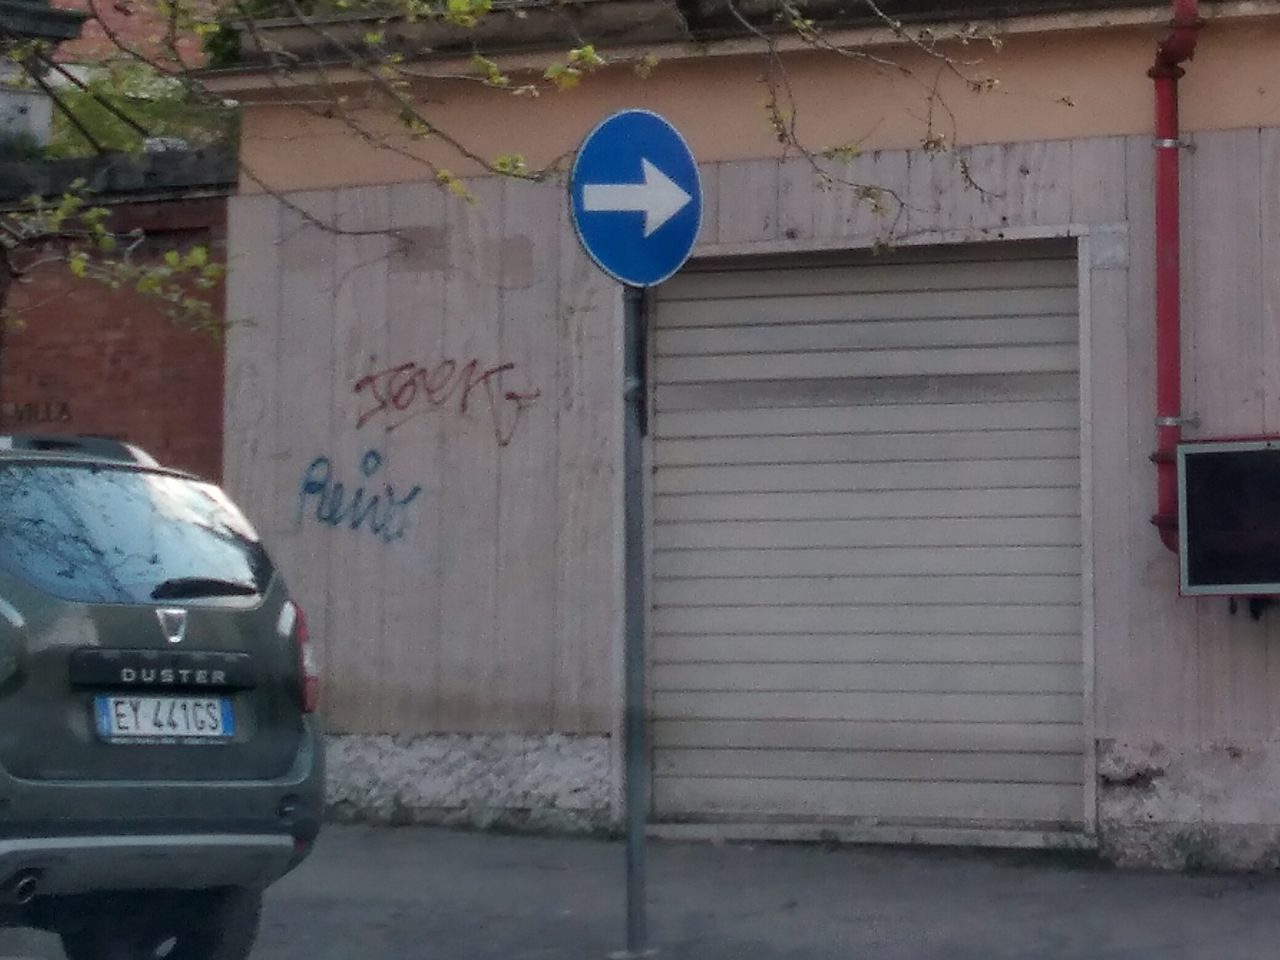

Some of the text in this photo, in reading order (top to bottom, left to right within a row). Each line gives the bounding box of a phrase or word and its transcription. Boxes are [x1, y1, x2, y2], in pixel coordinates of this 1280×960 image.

[120, 668, 226, 684] DUSTER
[113, 700, 218, 731] EY 441GS
